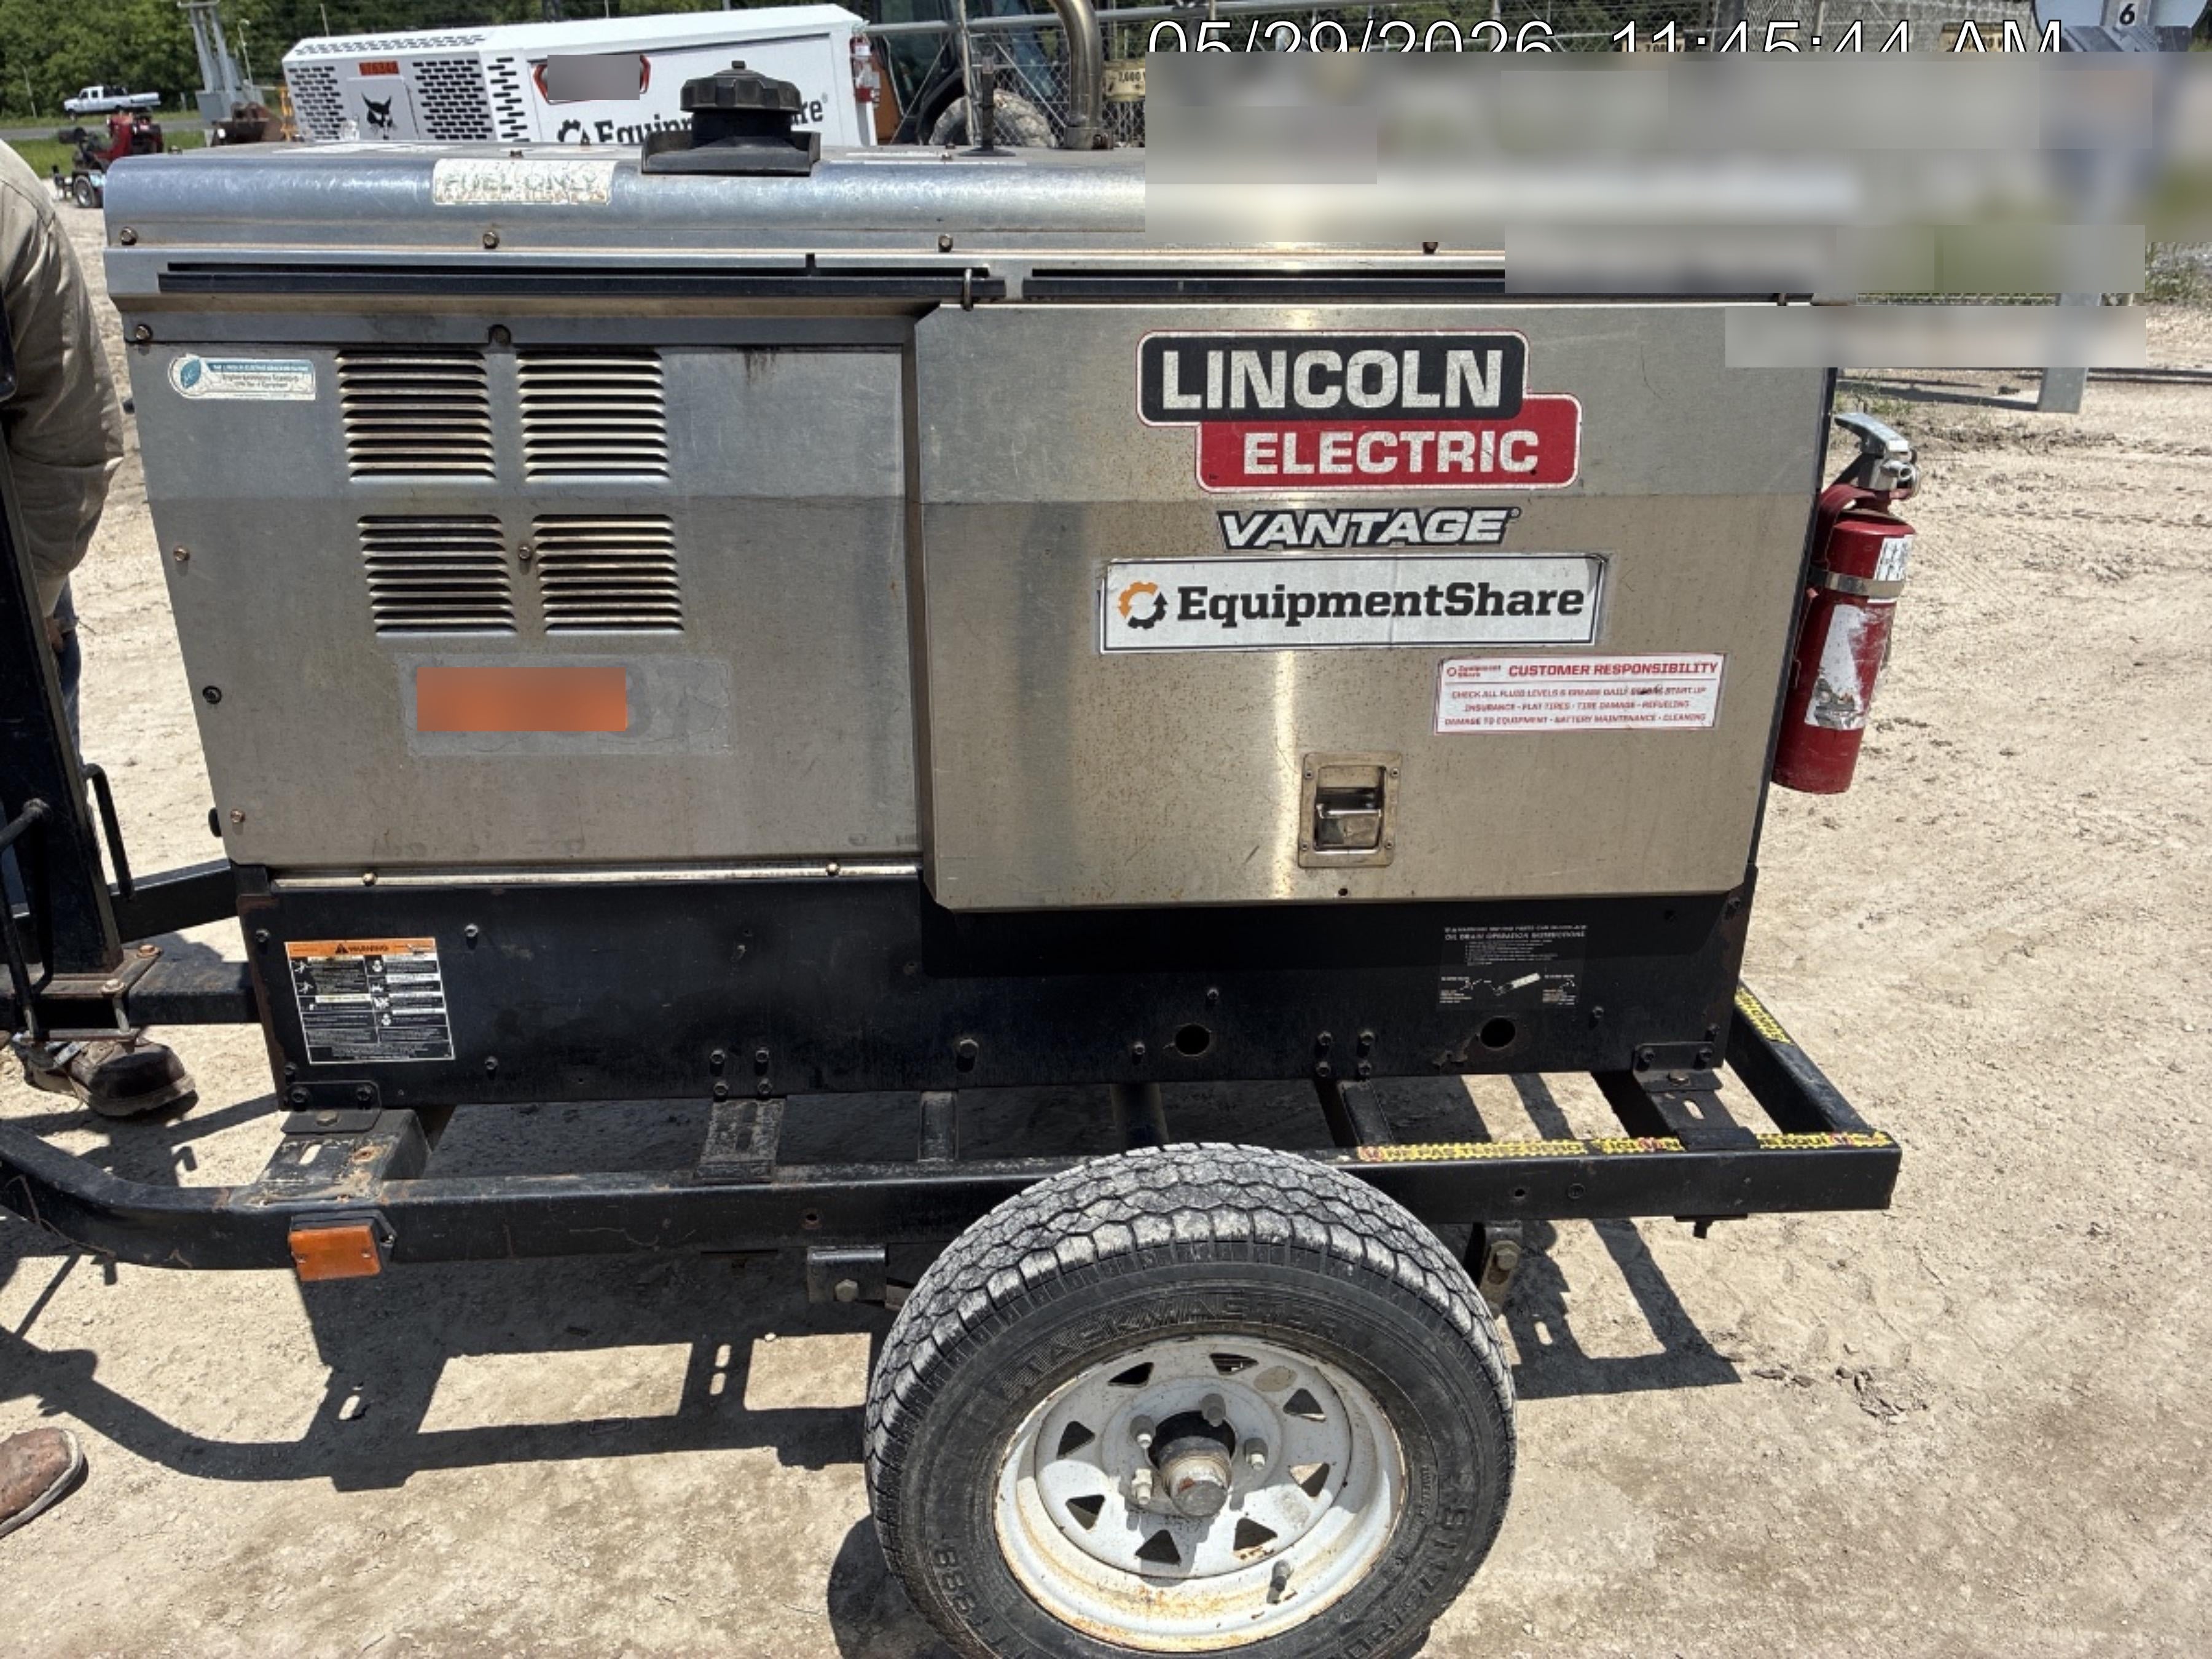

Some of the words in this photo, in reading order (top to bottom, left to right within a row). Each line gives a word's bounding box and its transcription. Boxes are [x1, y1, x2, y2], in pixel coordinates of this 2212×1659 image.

[2119, 2, 2136, 25] 6
[1162, 350, 1504, 410] LINCOLN
[1242, 429, 1540, 475] ELECTRIC
[1219, 509, 1509, 549] VANTAGE
[1177, 581, 1585, 629] EquipmentShare
[1508, 664, 1590, 677] CUSTOMER
[1593, 662, 1719, 675] RESPONSIBILITY
[1451, 689, 1481, 699] CHECK
[1528, 689, 1558, 697] LEVELS
[1465, 703, 1515, 712] INSURANCE
[1483, 716, 1495, 725] TO
[1496, 716, 1548, 725] EQUIPMENT
[1594, 715, 1655, 723] MAINTENANCE
